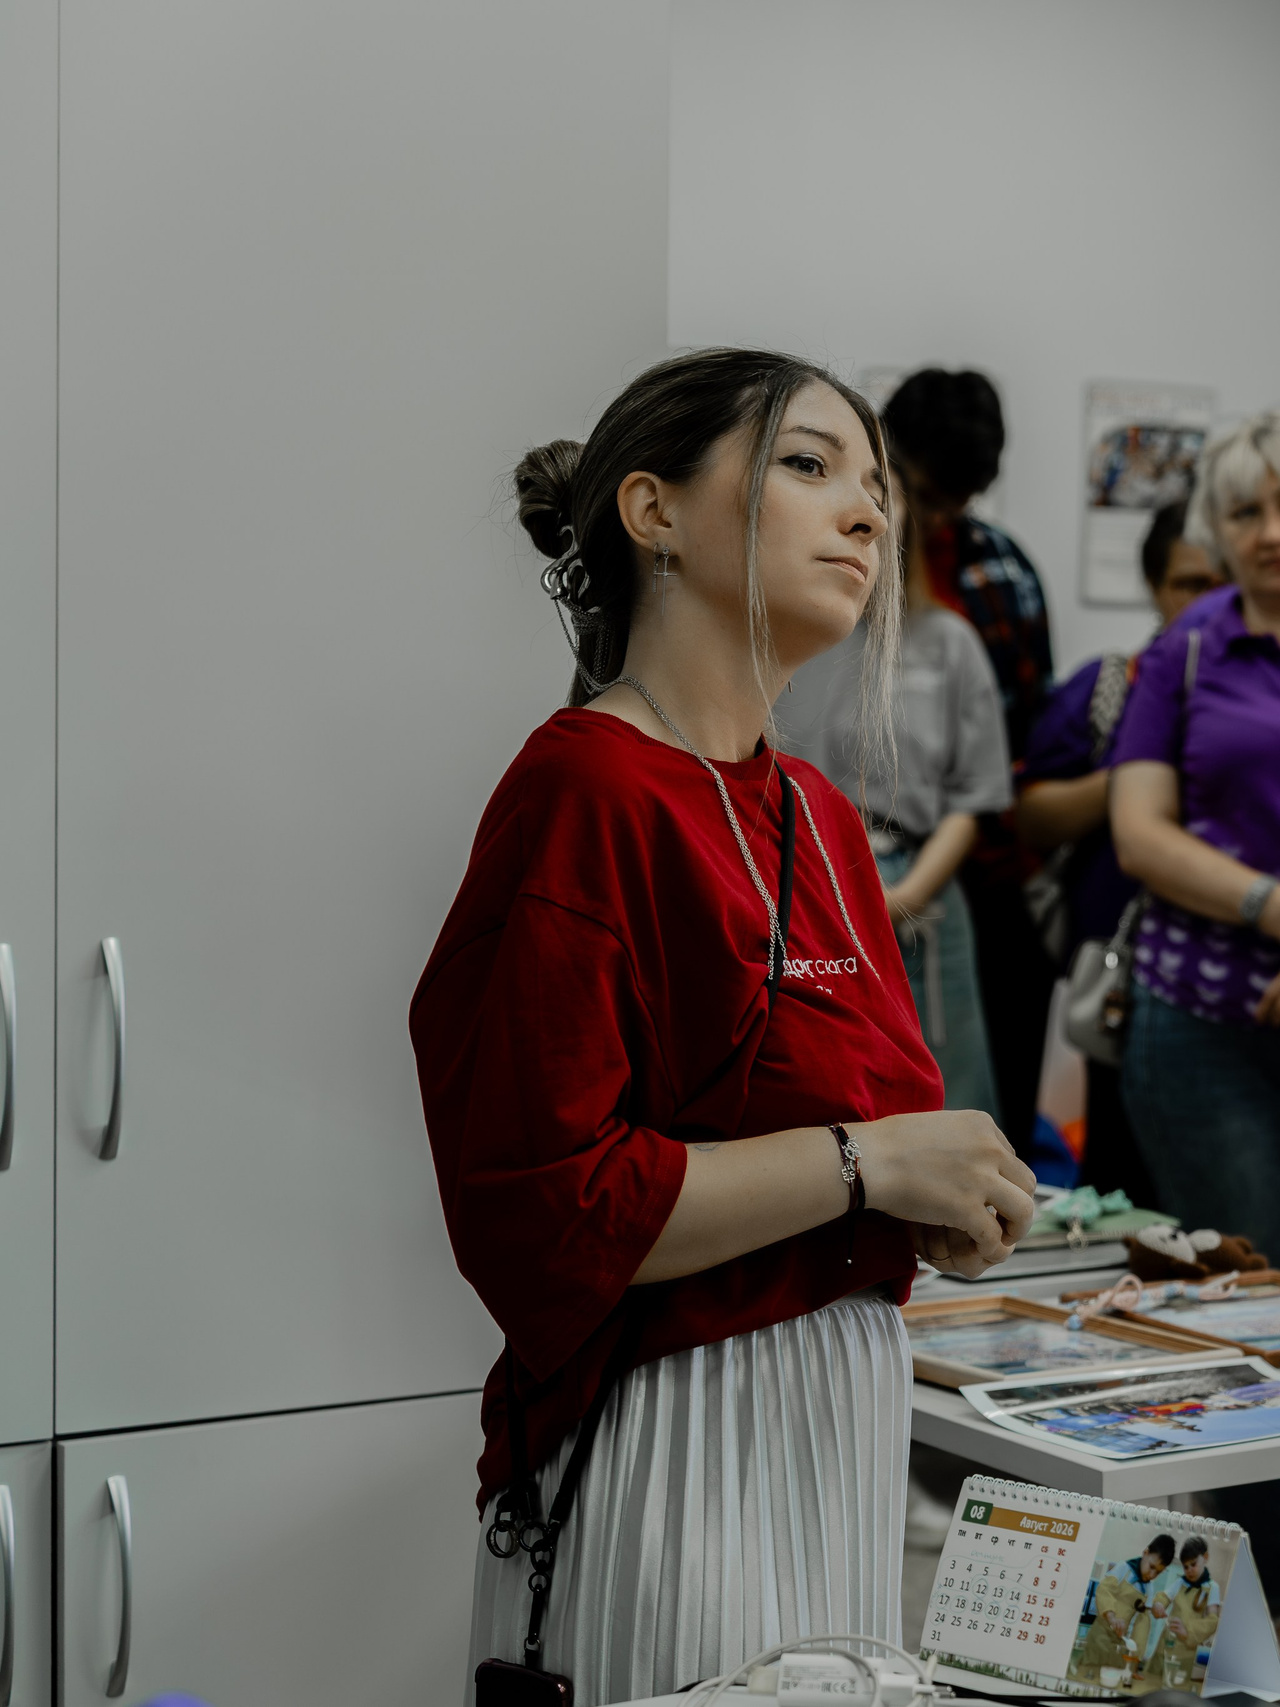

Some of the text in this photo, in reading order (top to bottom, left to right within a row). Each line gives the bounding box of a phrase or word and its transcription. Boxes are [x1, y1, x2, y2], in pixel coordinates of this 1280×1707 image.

[970, 1505, 1074, 1537] 08 Август 2026
[949, 1559, 1057, 1590] 3 4 5 6 7 8 9
[1038, 1559, 1062, 1573] 1 2
[943, 1577, 1055, 1609] 10 11 12 13 14 15 16
[939, 1594, 951, 1605] 17
[955, 1598, 967, 1609] 18
[971, 1601, 983, 1613] 19
[987, 1604, 1000, 1616] 20
[1003, 1608, 1015, 1620] 21
[1021, 1611, 1033, 1624] 22
[1037, 1615, 1050, 1627] 23
[930, 1629, 941, 1642] 31
[934, 1612, 1046, 1645] 24 25 26 27 28 29 30
